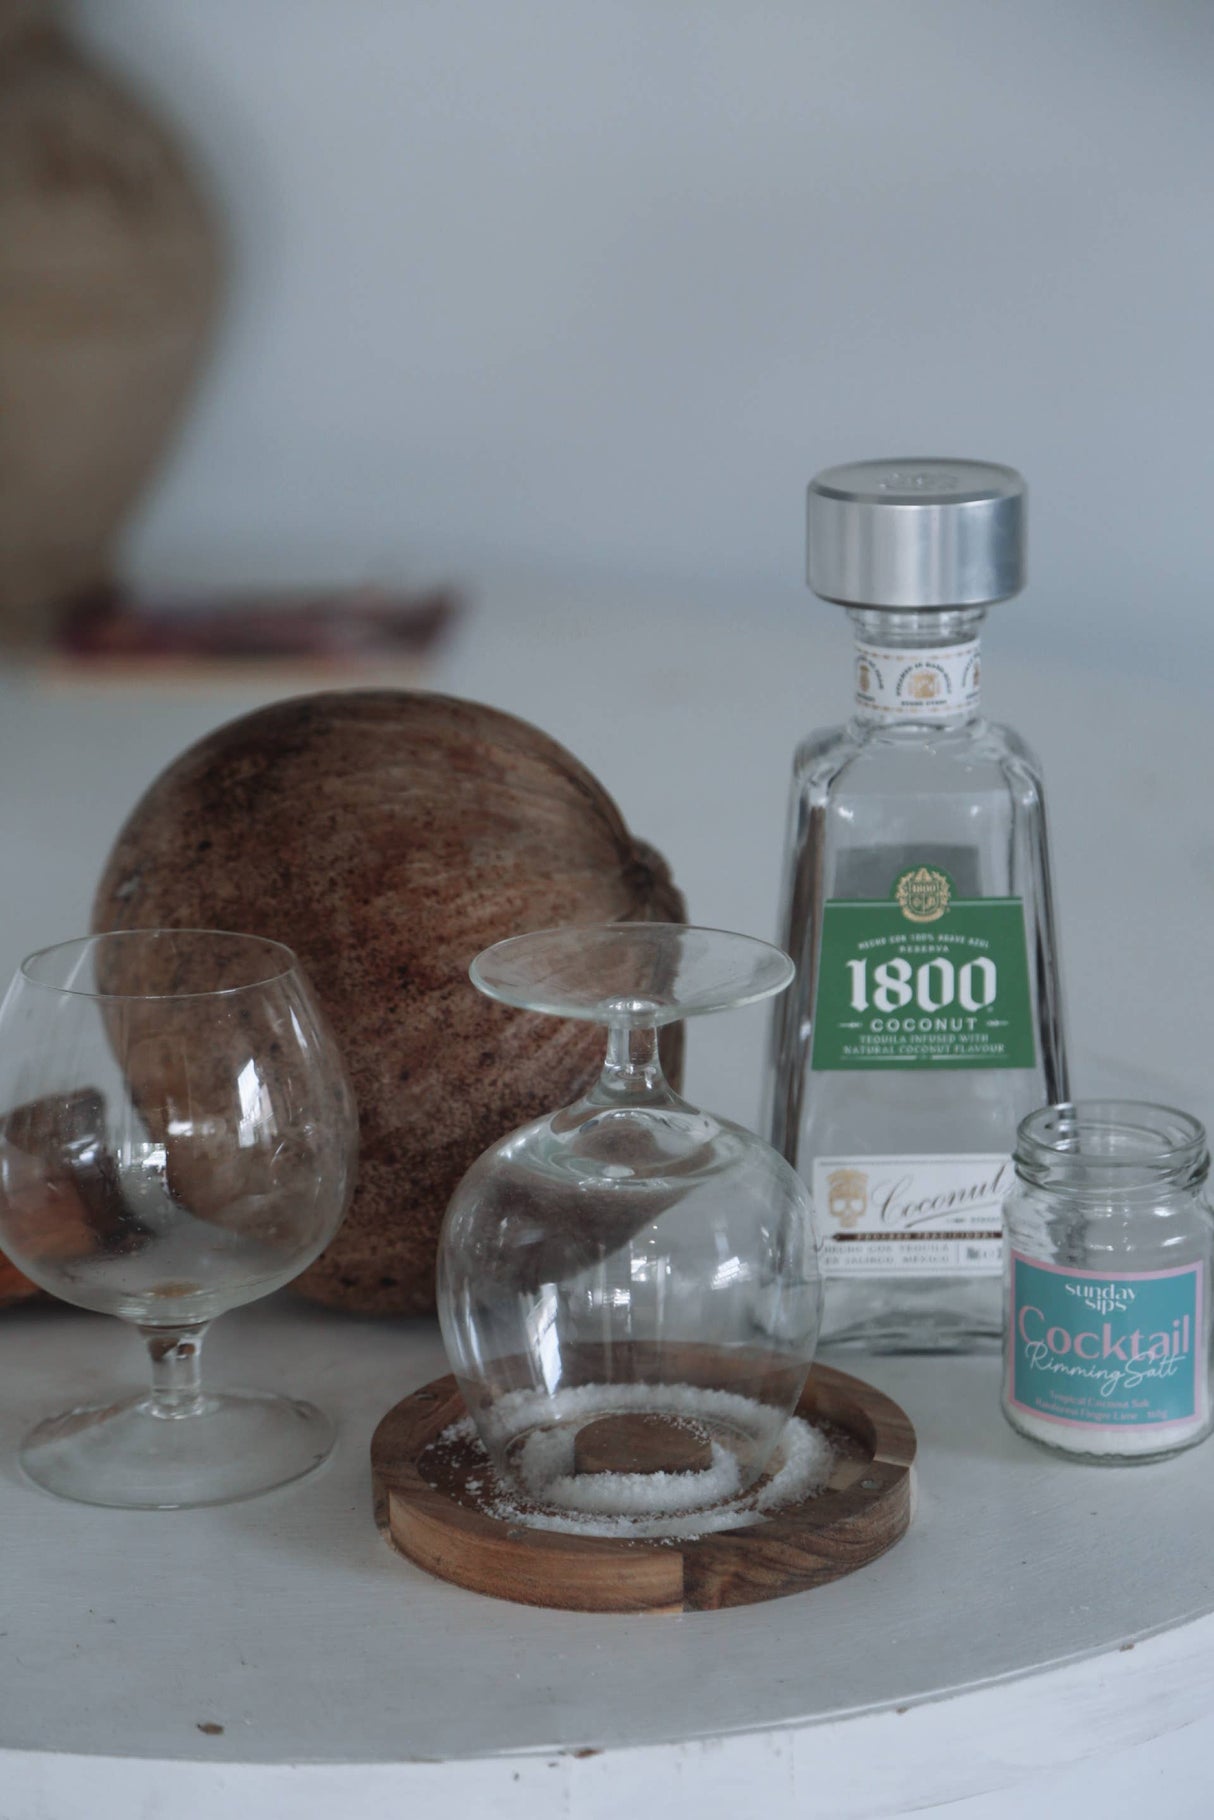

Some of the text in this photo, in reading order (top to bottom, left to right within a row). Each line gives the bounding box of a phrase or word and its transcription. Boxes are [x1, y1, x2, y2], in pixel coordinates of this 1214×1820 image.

[898, 945, 950, 954] RESERVA
[845, 957, 997, 1013] 1800
[869, 1017, 977, 1033] COCONUT
[843, 1043, 1005, 1055] NATURAL COCONUT FLAVOUR
[859, 1033, 989, 1044] TEQUILA INFUSED WITH
[1064, 1283, 1137, 1304] sunday
[1084, 1295, 1127, 1316] sips
[1018, 1304, 1190, 1361] Cocktail
[1024, 1341, 1187, 1397] Rimming Salt
